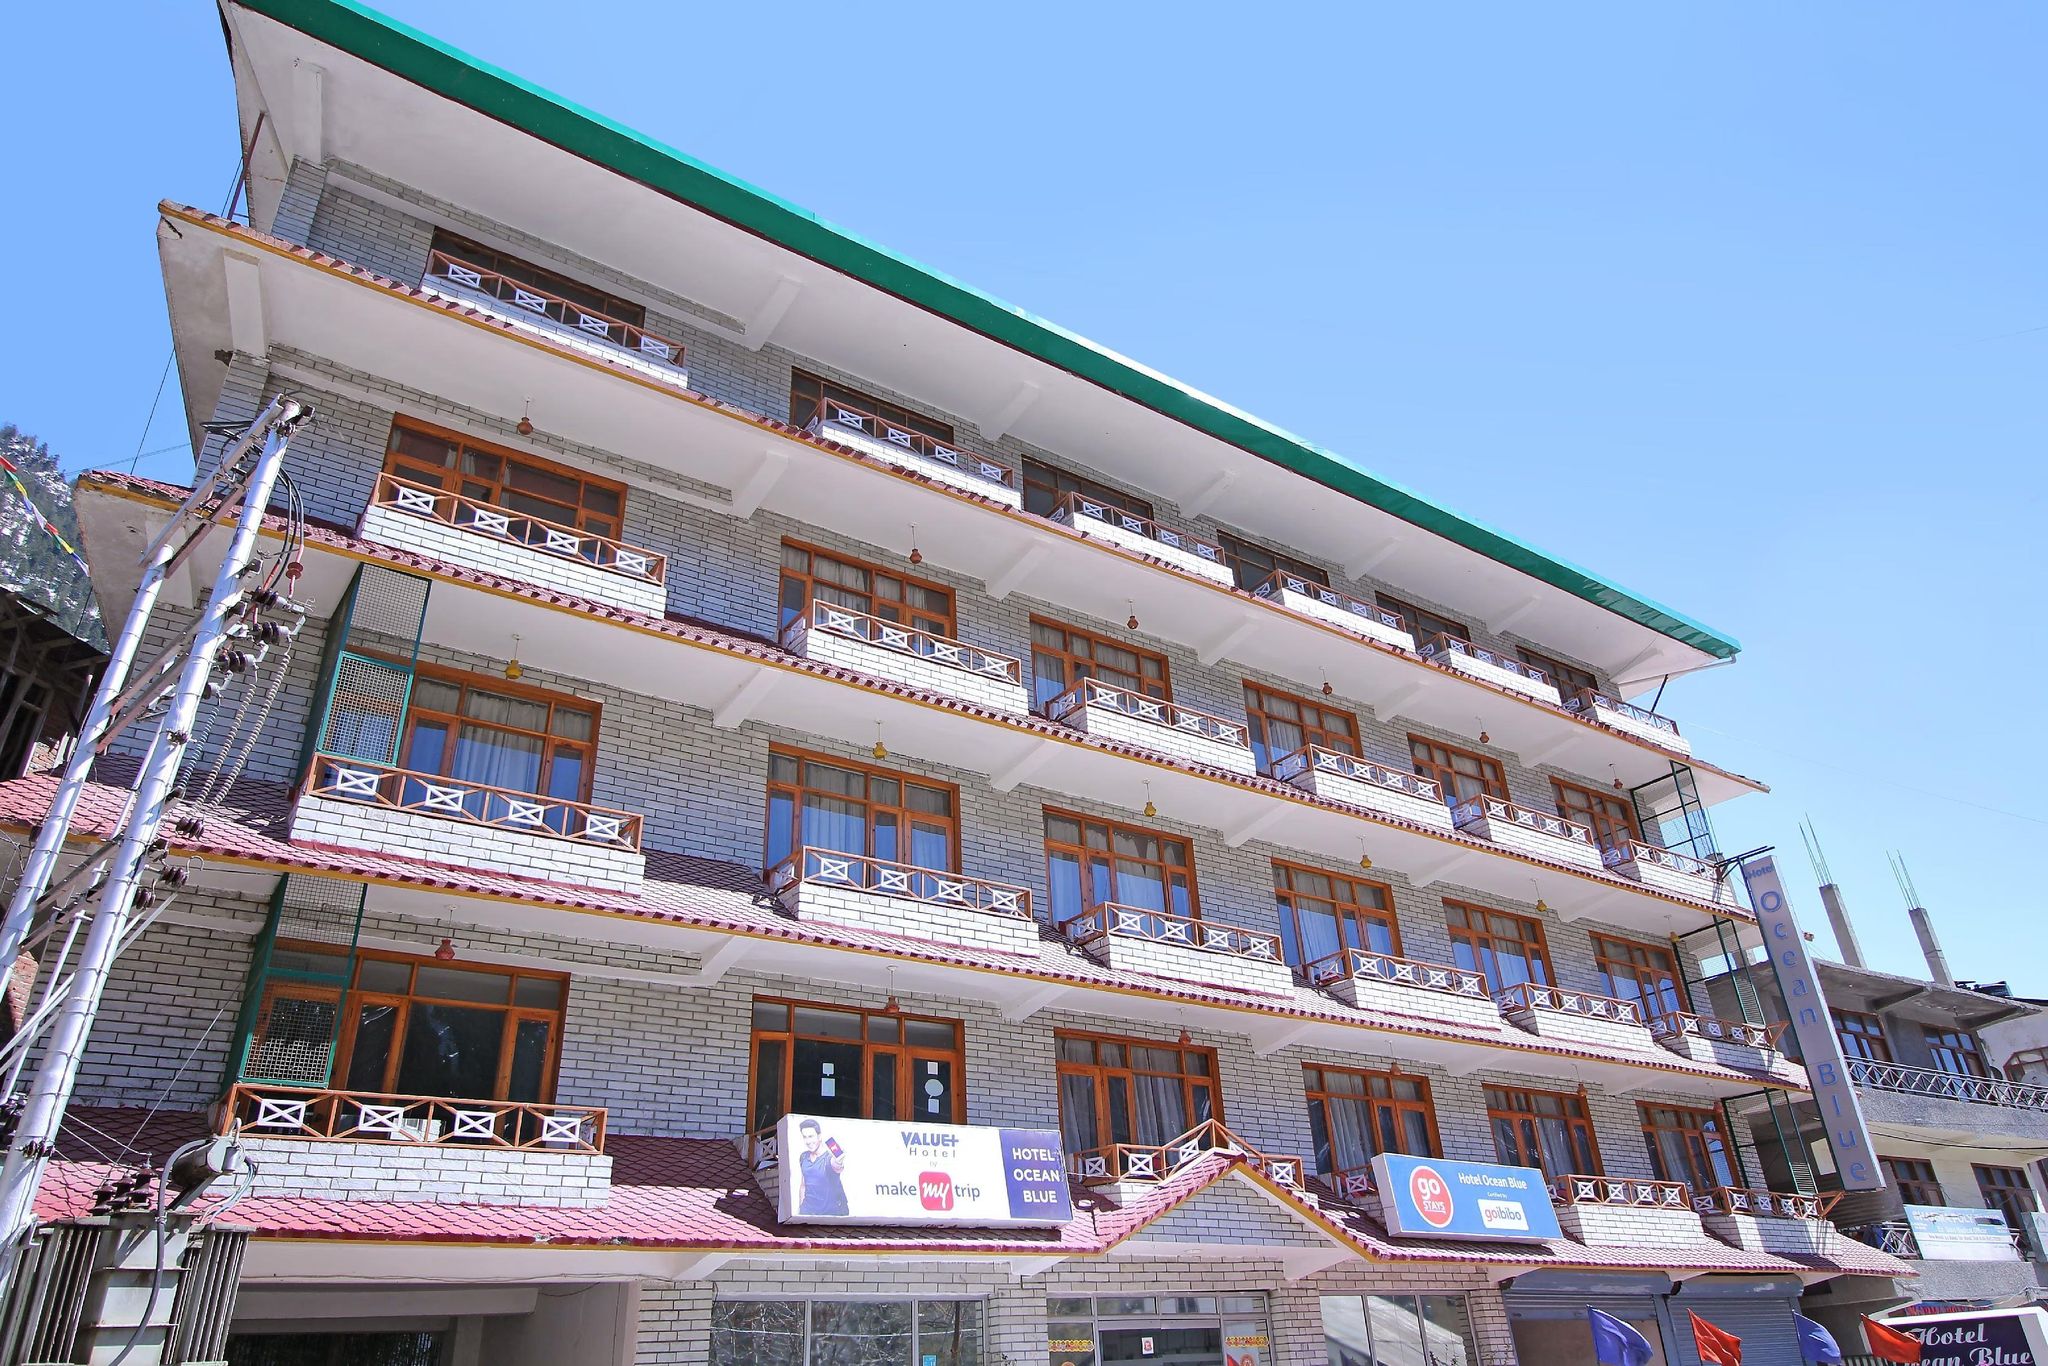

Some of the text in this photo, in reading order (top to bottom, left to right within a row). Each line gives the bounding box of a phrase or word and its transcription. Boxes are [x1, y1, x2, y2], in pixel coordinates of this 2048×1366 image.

[1747, 864, 1774, 880] Hotel
[1760, 890, 1867, 1182] Ocean Blue
[910, 1147, 956, 1158] Hotel
[1012, 1147, 1056, 1161] HOTEL
[1013, 1168, 1060, 1182] OCEAN
[1458, 1173, 1528, 1190] Hotel Ocean Blue
[875, 1181, 980, 1209] make my trip
[1023, 1190, 1057, 1203] BLUE
[1417, 1178, 1441, 1200] go
[1423, 1201, 1445, 1211] STAYS
[1485, 1206, 1522, 1222] goibibo
[1909, 1324, 1988, 1346] Hotel
[1969, 1347, 2034, 1366] Blue
